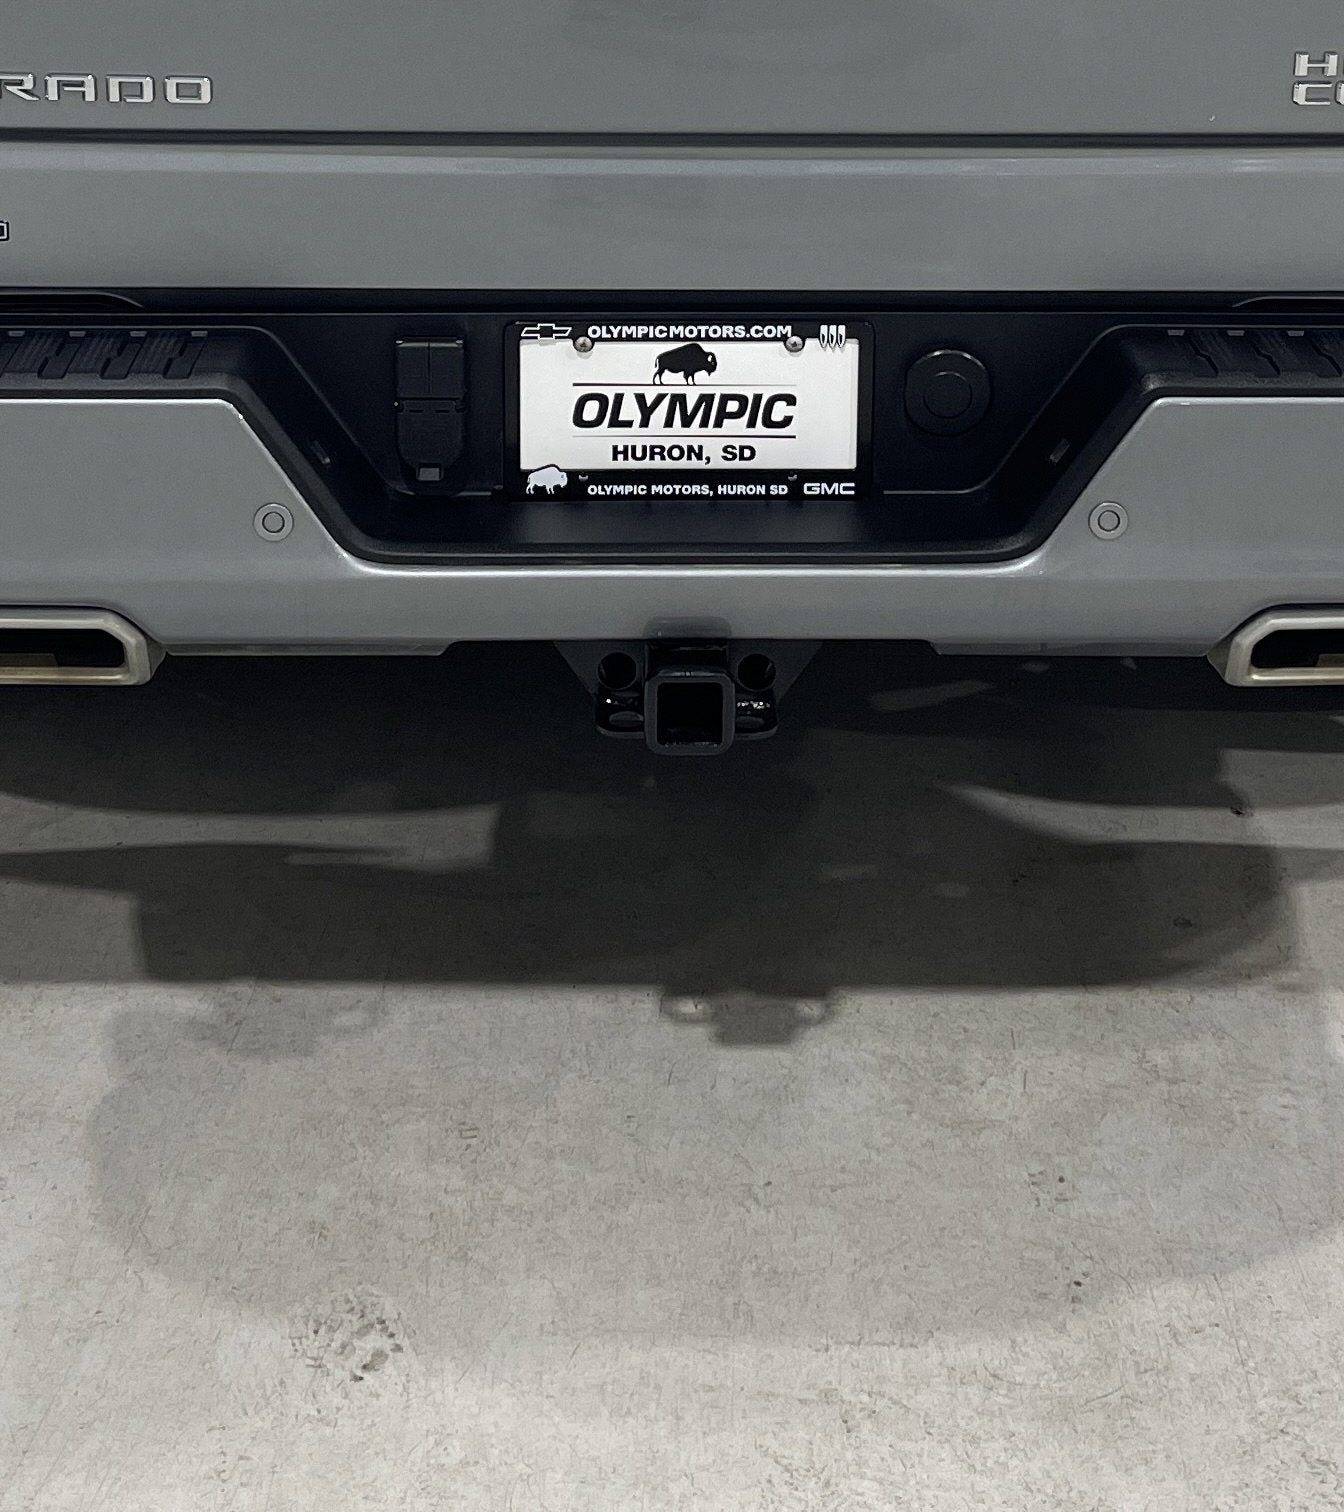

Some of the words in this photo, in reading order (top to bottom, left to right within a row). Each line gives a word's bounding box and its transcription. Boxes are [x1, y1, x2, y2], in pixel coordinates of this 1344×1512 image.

[587, 325, 792, 338] OLYMPICMOTORS.COM
[572, 393, 797, 429] OLYMPIC
[611, 445, 712, 465] HURON,
[721, 445, 756, 462] SD
[587, 484, 648, 496] OLYMPIC
[651, 484, 714, 497] MOTORS,
[717, 484, 766, 495] HURON
[770, 485, 788, 495] SD
[803, 483, 855, 495] GMC
